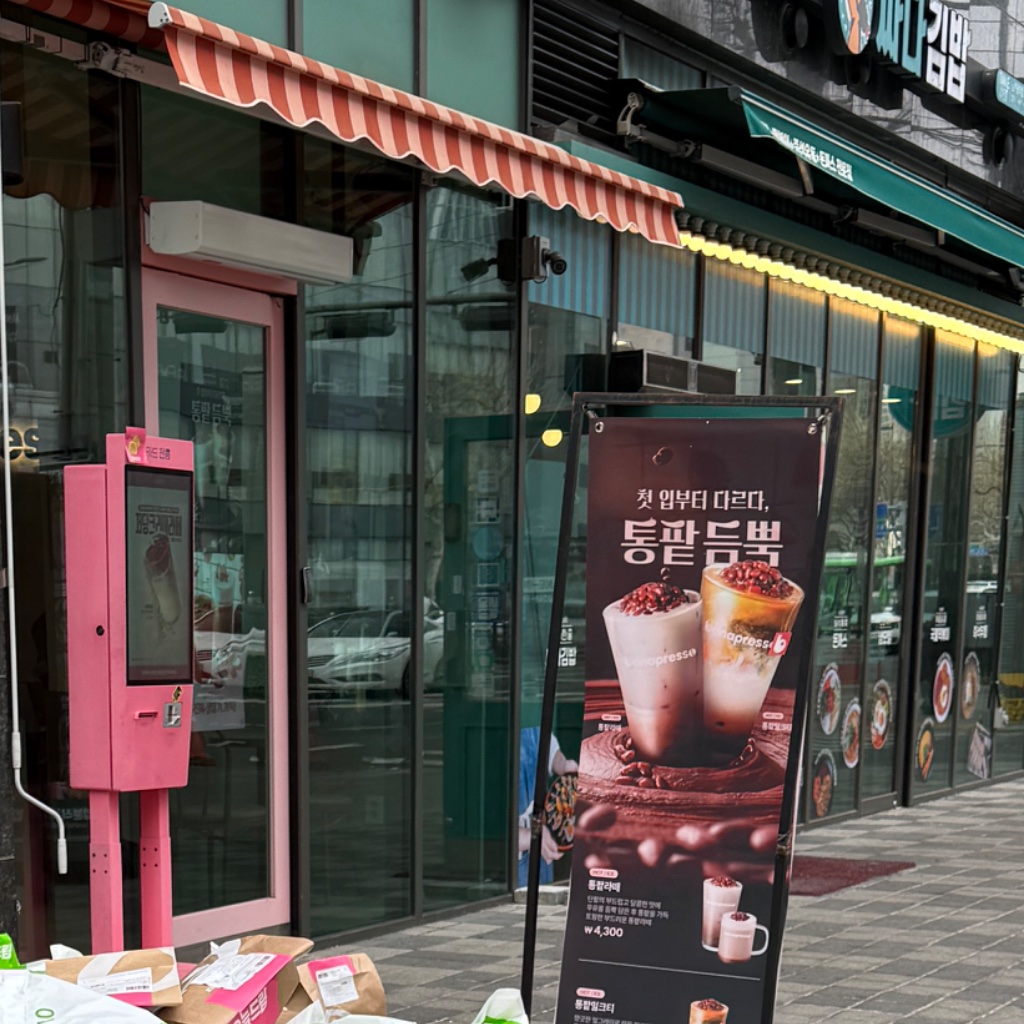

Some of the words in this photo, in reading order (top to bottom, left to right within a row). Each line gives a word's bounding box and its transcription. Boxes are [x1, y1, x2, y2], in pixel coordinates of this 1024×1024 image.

[636, 488, 653, 510] 첫
[659, 490, 707, 511] 입부터
[713, 490, 769, 513] 다르다,
